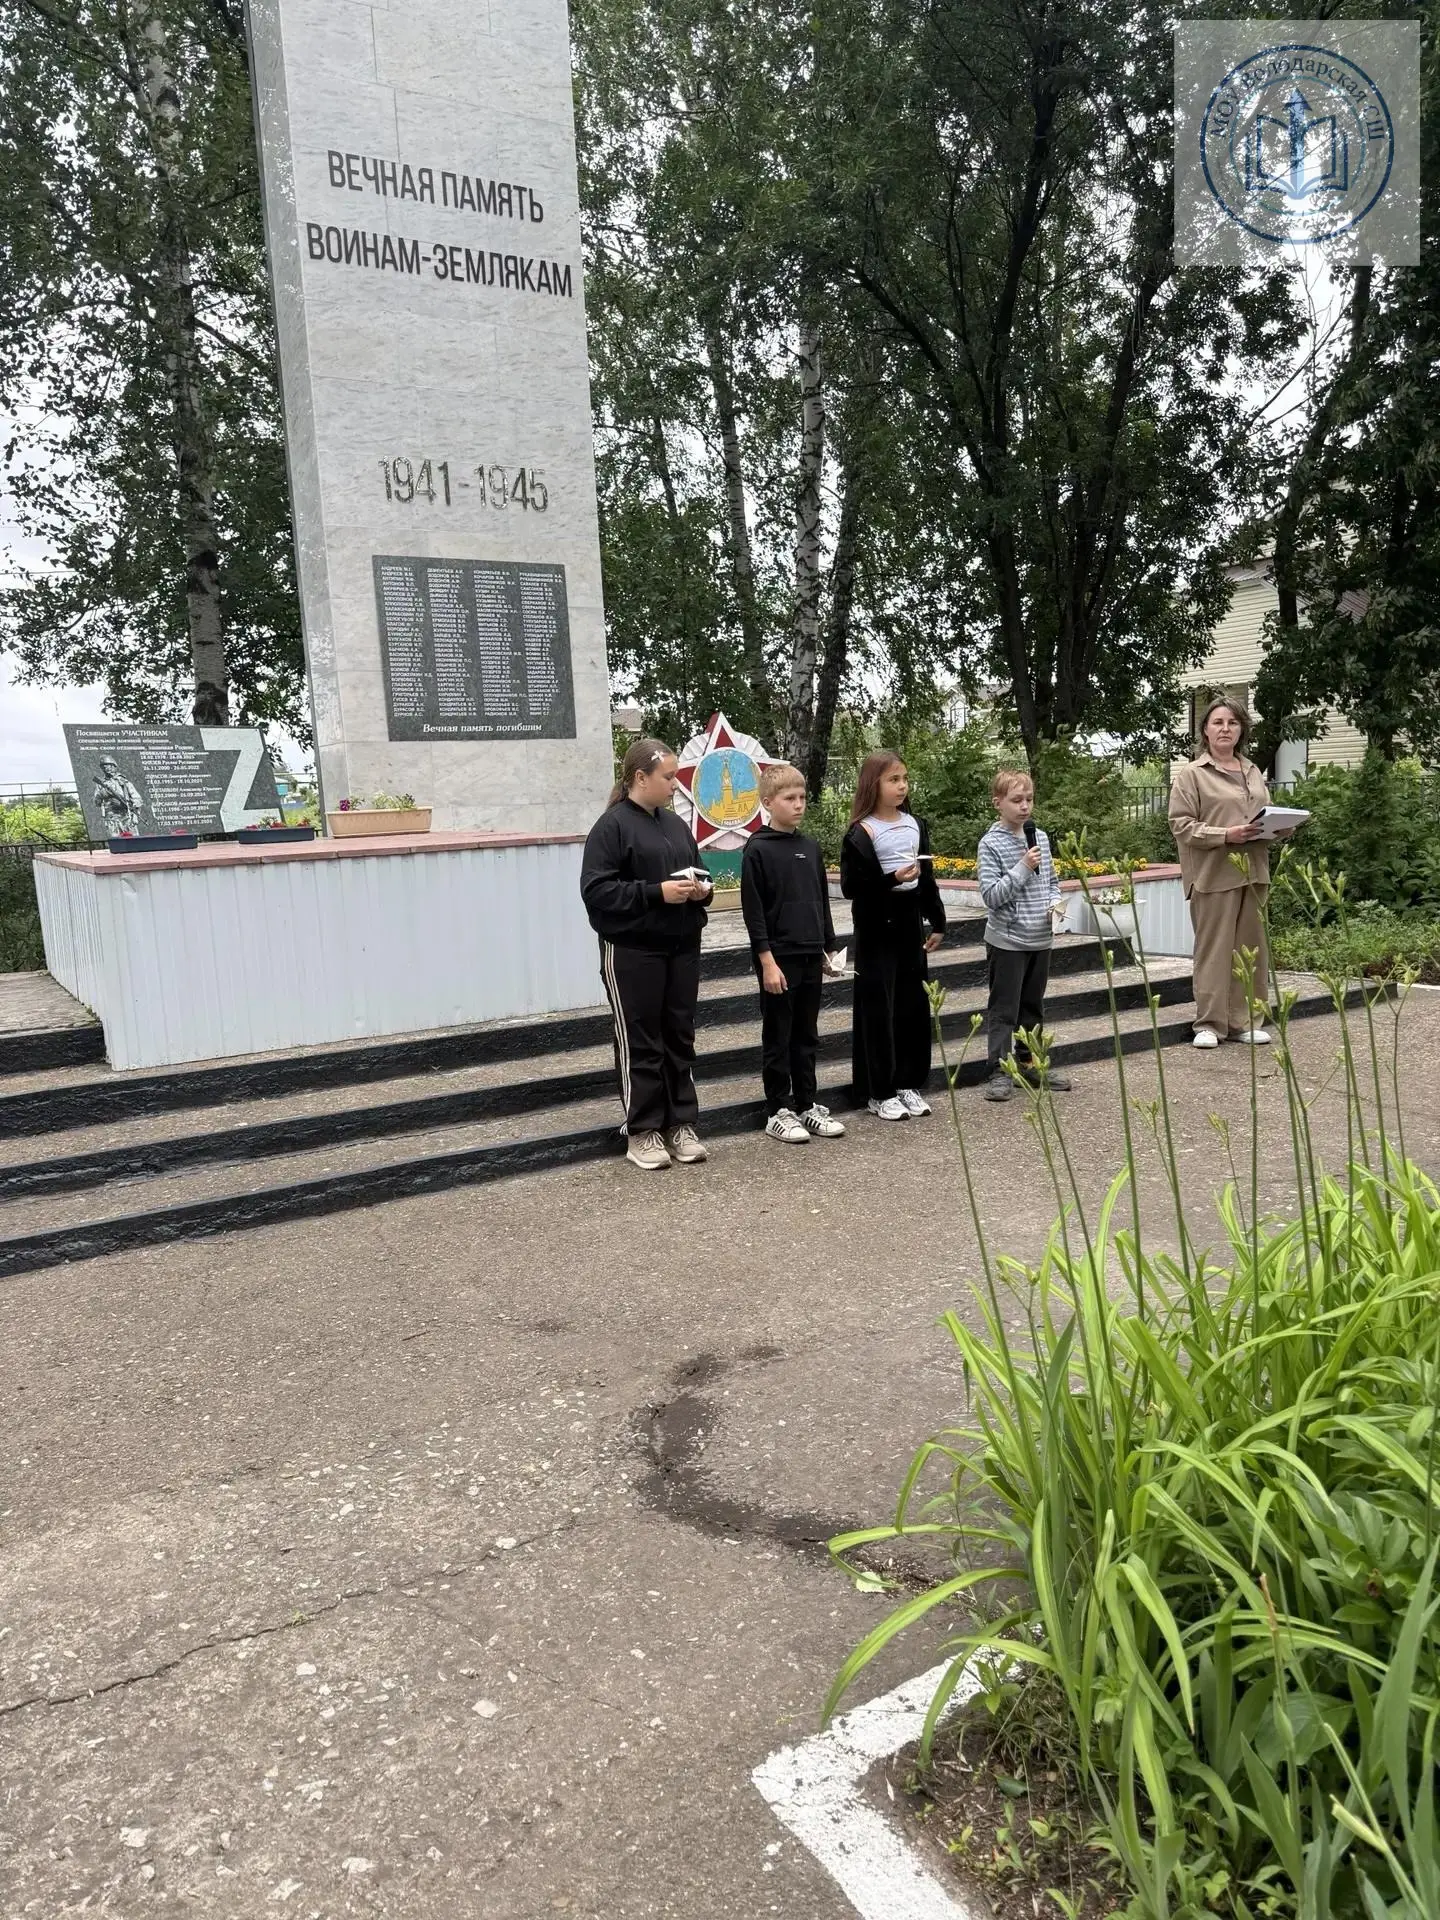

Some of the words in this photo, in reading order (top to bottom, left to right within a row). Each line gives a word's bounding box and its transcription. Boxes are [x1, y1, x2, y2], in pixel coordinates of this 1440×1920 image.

[328, 150, 435, 204] ВЕЧНАЯ
[441, 171, 544, 223] ПАМЯТЬ
[306, 222, 573, 297] ВОИНАМ-ЗЕМЛЯКАМ
[423, 724, 458, 733] Вечная
[461, 724, 494, 733] память
[496, 722, 542, 733] погибшим
